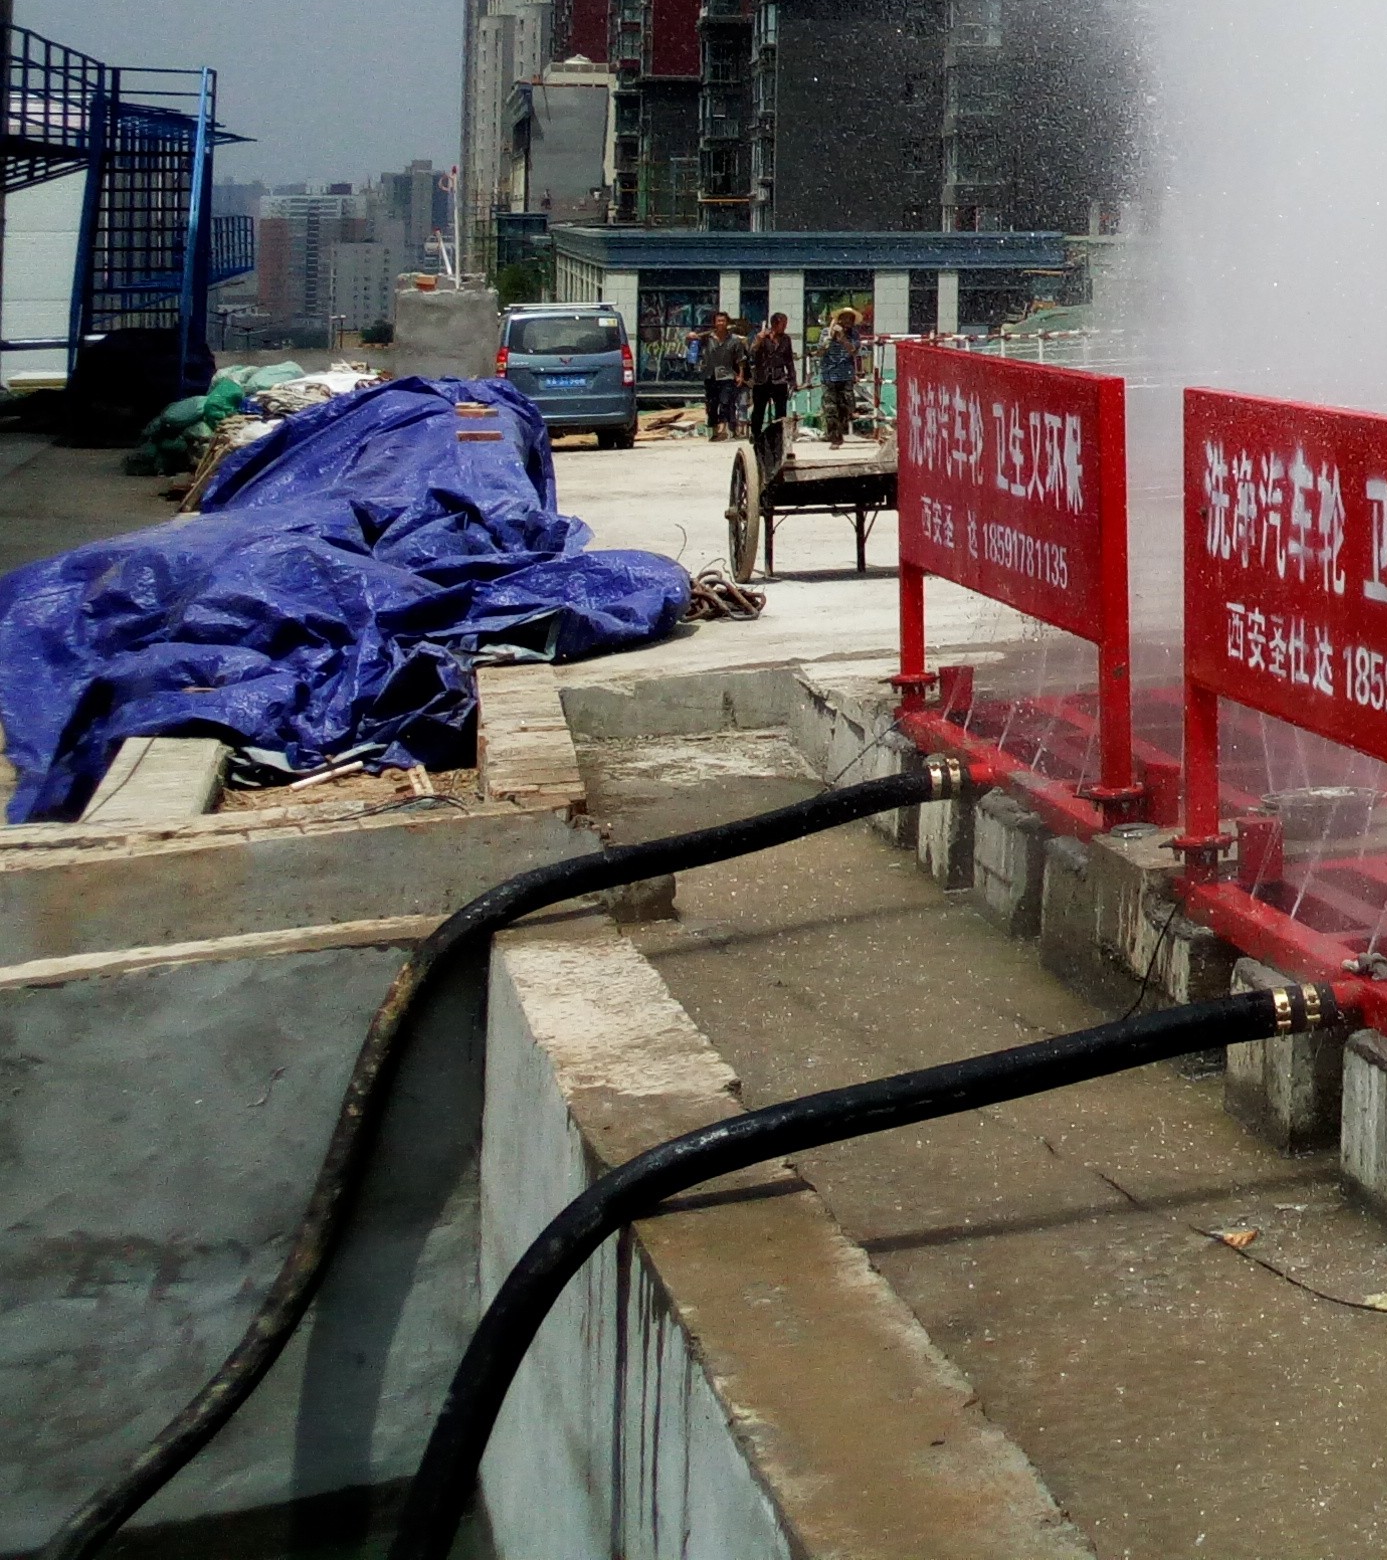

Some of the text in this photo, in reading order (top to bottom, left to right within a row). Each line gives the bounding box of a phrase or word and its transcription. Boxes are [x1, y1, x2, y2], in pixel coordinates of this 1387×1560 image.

[907, 376, 1084, 516] 洗净汽车轮 卫生又环保
[982, 522, 1069, 590] 18591781135
[1204, 440, 1346, 596] 洗净汽车轮
[1226, 601, 1334, 696] 西安圣仕达
